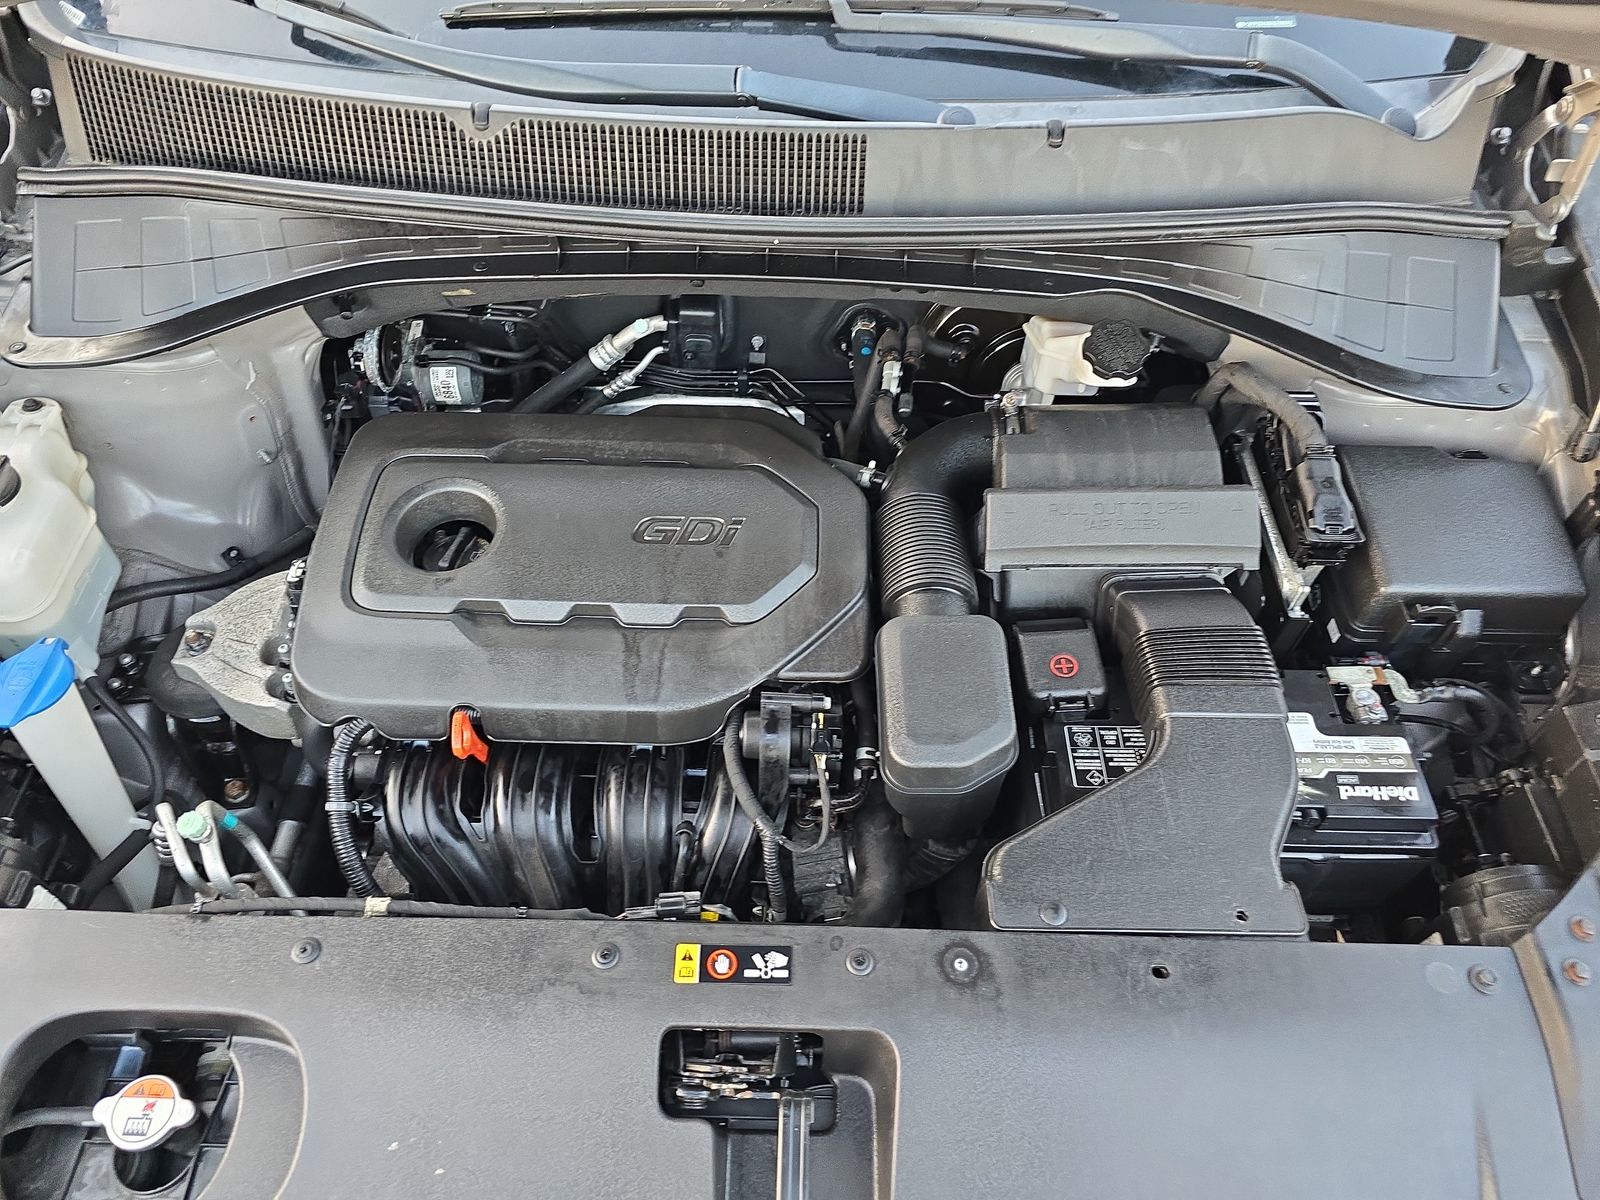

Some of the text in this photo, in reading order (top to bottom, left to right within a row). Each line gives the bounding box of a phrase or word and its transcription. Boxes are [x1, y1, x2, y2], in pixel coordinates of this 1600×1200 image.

[1049, 502, 1200, 516] PULL OUT TO OPEN
[632, 515, 747, 546] GDi
[1338, 786, 1420, 801] DieHard
